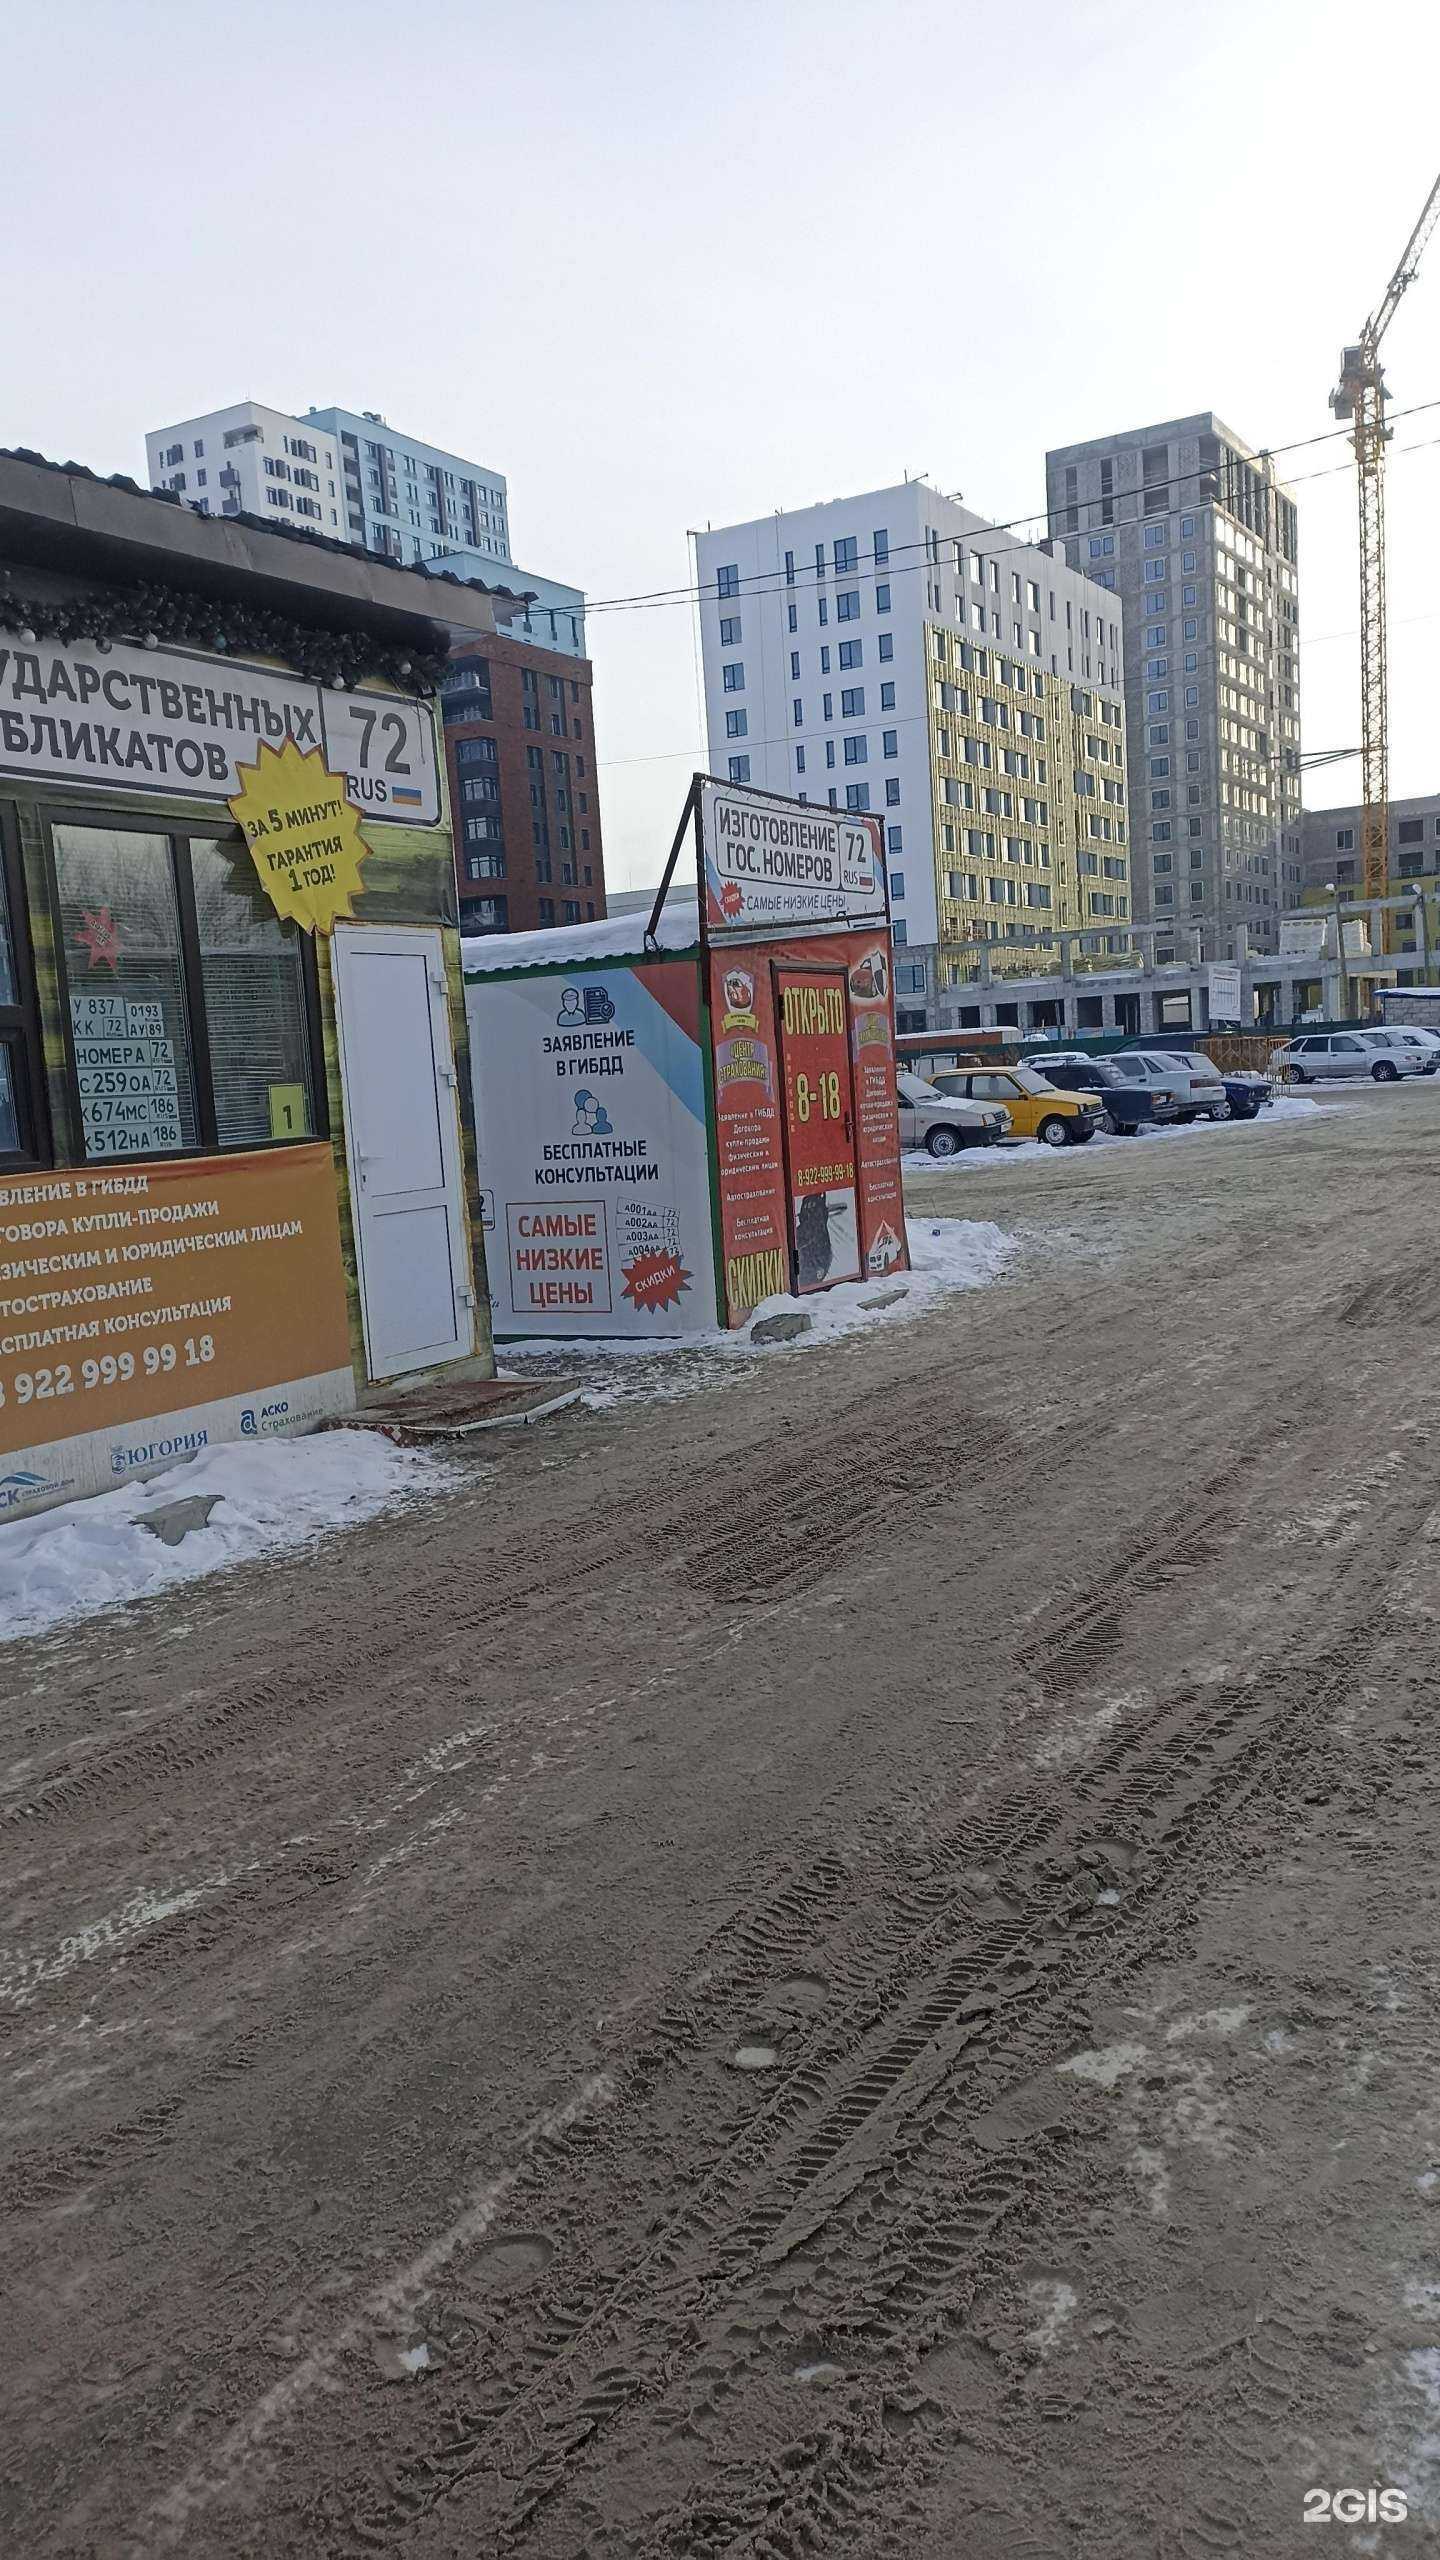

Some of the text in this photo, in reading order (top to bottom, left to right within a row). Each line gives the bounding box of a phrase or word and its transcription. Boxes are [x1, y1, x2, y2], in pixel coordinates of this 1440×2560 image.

[0, 709, 229, 780] БЛИКАТОВ
[349, 706, 411, 775] 72
[347, 774, 388, 802] RUS
[247, 800, 344, 838] ЗА 5 МИНУТ!
[719, 807, 836, 853] ИЗГОТОВЛЕНИЕ
[266, 836, 343, 871] ГАРАНТИЯ
[845, 832, 867, 863] 72
[726, 842, 833, 883] ГОС. НОМЕРОВ
[288, 864, 336, 891] 1 ГОД!
[843, 870, 859, 886] RUS
[747, 894, 846, 910] САМЫЕ НИЗКИЕ ЦЕНЫ
[88, 999, 115, 1015] 837
[784, 986, 844, 1035] ОТКРЫТО
[108, 1019, 121, 1032] 72
[149, 1024, 162, 1037] 89
[152, 1042, 168, 1057] 72
[542, 1029, 635, 1053] ЗАЯВЛЕНИЕ
[76, 1048, 145, 1065] НОМЕРА
[556, 1055, 623, 1076] В ГИБДД
[154, 1070, 171, 1085] 72
[151, 1098, 174, 1114] 186
[797, 1071, 840, 1122] 8-18
[282, 1104, 292, 1129] 1
[153, 1126, 177, 1141] 186
[543, 1140, 647, 1161] БЕСПЛАТНЫЕ
[535, 1163, 659, 1185] КОНСУЛЬТАЦИИ
[0, 1175, 149, 1206] ВЛЕНИЕ В ГИБДД
[72, 1200, 220, 1234] КУПЛИ-ПРОДАЖИ
[518, 1214, 597, 1238] САМЫЕ
[0, 1220, 303, 1281] ЗИЧЕСКИМ И ЮРИДИЧЕСКИМ ЛИЦАМ
[516, 1248, 604, 1271] НИЗКИЕ
[635, 1265, 676, 1292] СКИДКИ
[728, 1248, 785, 1310] СКИДКИ
[0, 1276, 153, 1318] ТОСТРАХОВАНИЕ
[529, 1282, 594, 1307] ЦЕНЫ
[0, 1296, 232, 1355] СПЛАТНАЯ КОНСУЛЬТАЦИЯ
[14, 1364, 75, 1405] 922
[81, 1351, 135, 1389] 999
[142, 1343, 177, 1376] 99
[184, 1334, 216, 1367] 18
[261, 1401, 289, 1418] АСКО
[261, 1407, 324, 1432] Страхование
[127, 1430, 209, 1465] ЮГОРИЯ
